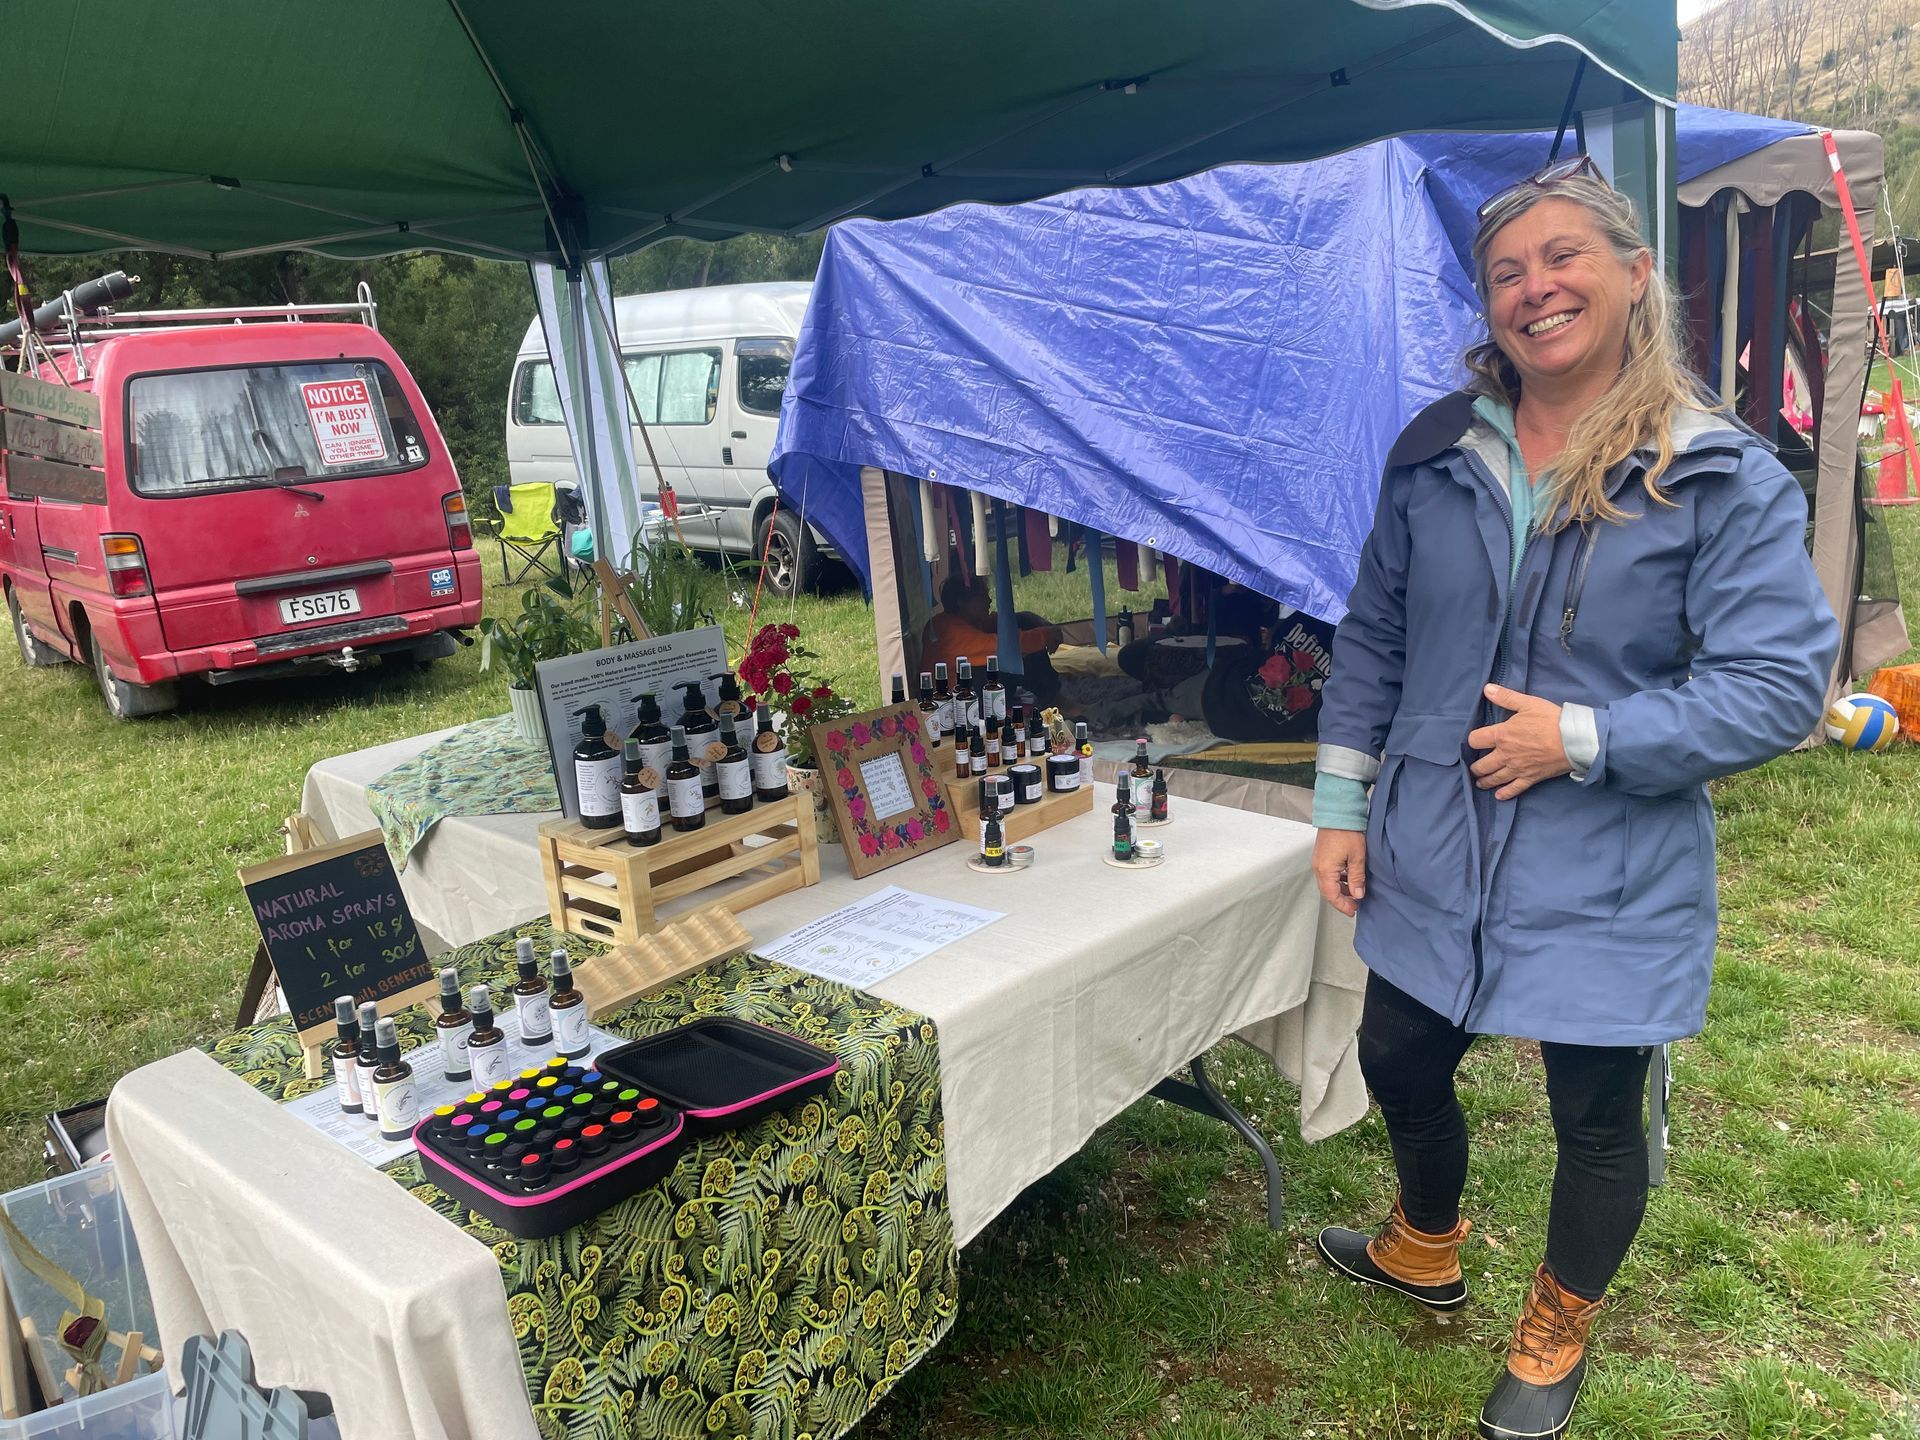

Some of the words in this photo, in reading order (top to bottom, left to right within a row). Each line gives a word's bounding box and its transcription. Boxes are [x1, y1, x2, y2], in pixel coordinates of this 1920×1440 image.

[307, 385, 364, 404] NOTICE
[316, 409, 336, 424] I'M
[338, 408, 367, 420] BUSY
[331, 422, 360, 436] NOW
[290, 593, 350, 618] FSG76
[596, 657, 615, 667] BODY
[624, 648, 656, 660] MASSAGE
[657, 644, 672, 653] OILS
[605, 668, 623, 676] Natural
[257, 883, 344, 920] NATURAL
[268, 915, 326, 944] AROMA
[332, 893, 396, 924] SPRAYS
[306, 946, 316, 960] 1
[328, 938, 352, 958] for
[321, 972, 338, 988] 2
[345, 962, 367, 979] for
[354, 985, 376, 1004] with
[378, 962, 432, 992] BENEFITS
